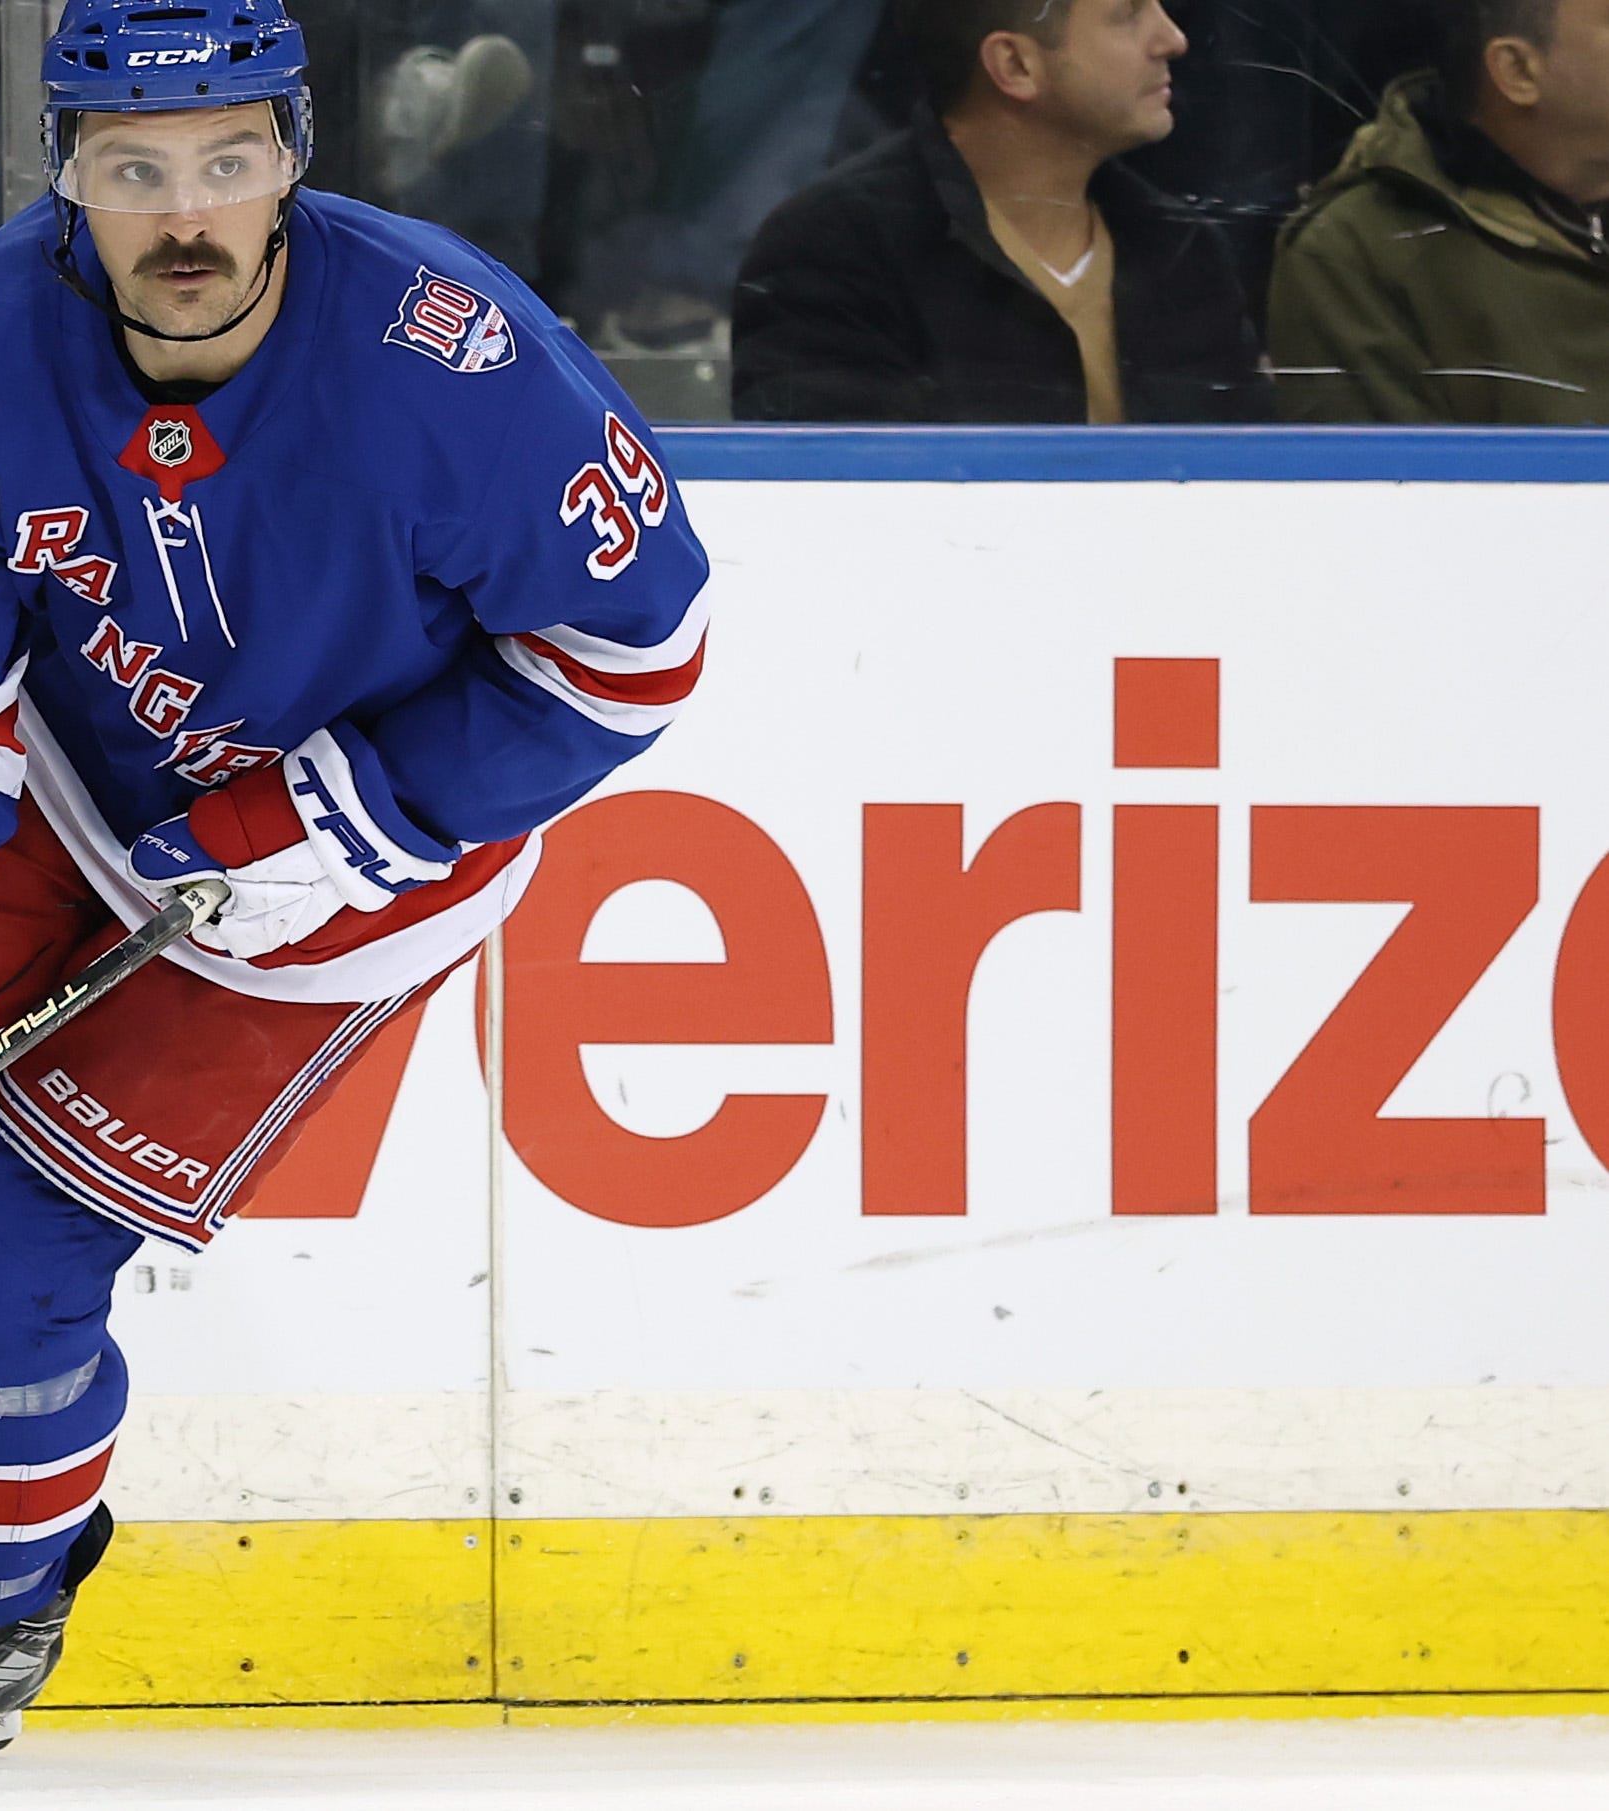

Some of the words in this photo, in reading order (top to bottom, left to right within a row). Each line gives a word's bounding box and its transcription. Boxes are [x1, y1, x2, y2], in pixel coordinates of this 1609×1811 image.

[127, 48, 213, 67] CCM
[404, 279, 479, 360] 100
[158, 432, 183, 456] NHL
[558, 410, 669, 581] 39
[139, 832, 191, 865] TRUE
[186, 889, 208, 911] 39
[236, 656, 1609, 1229] eriz
